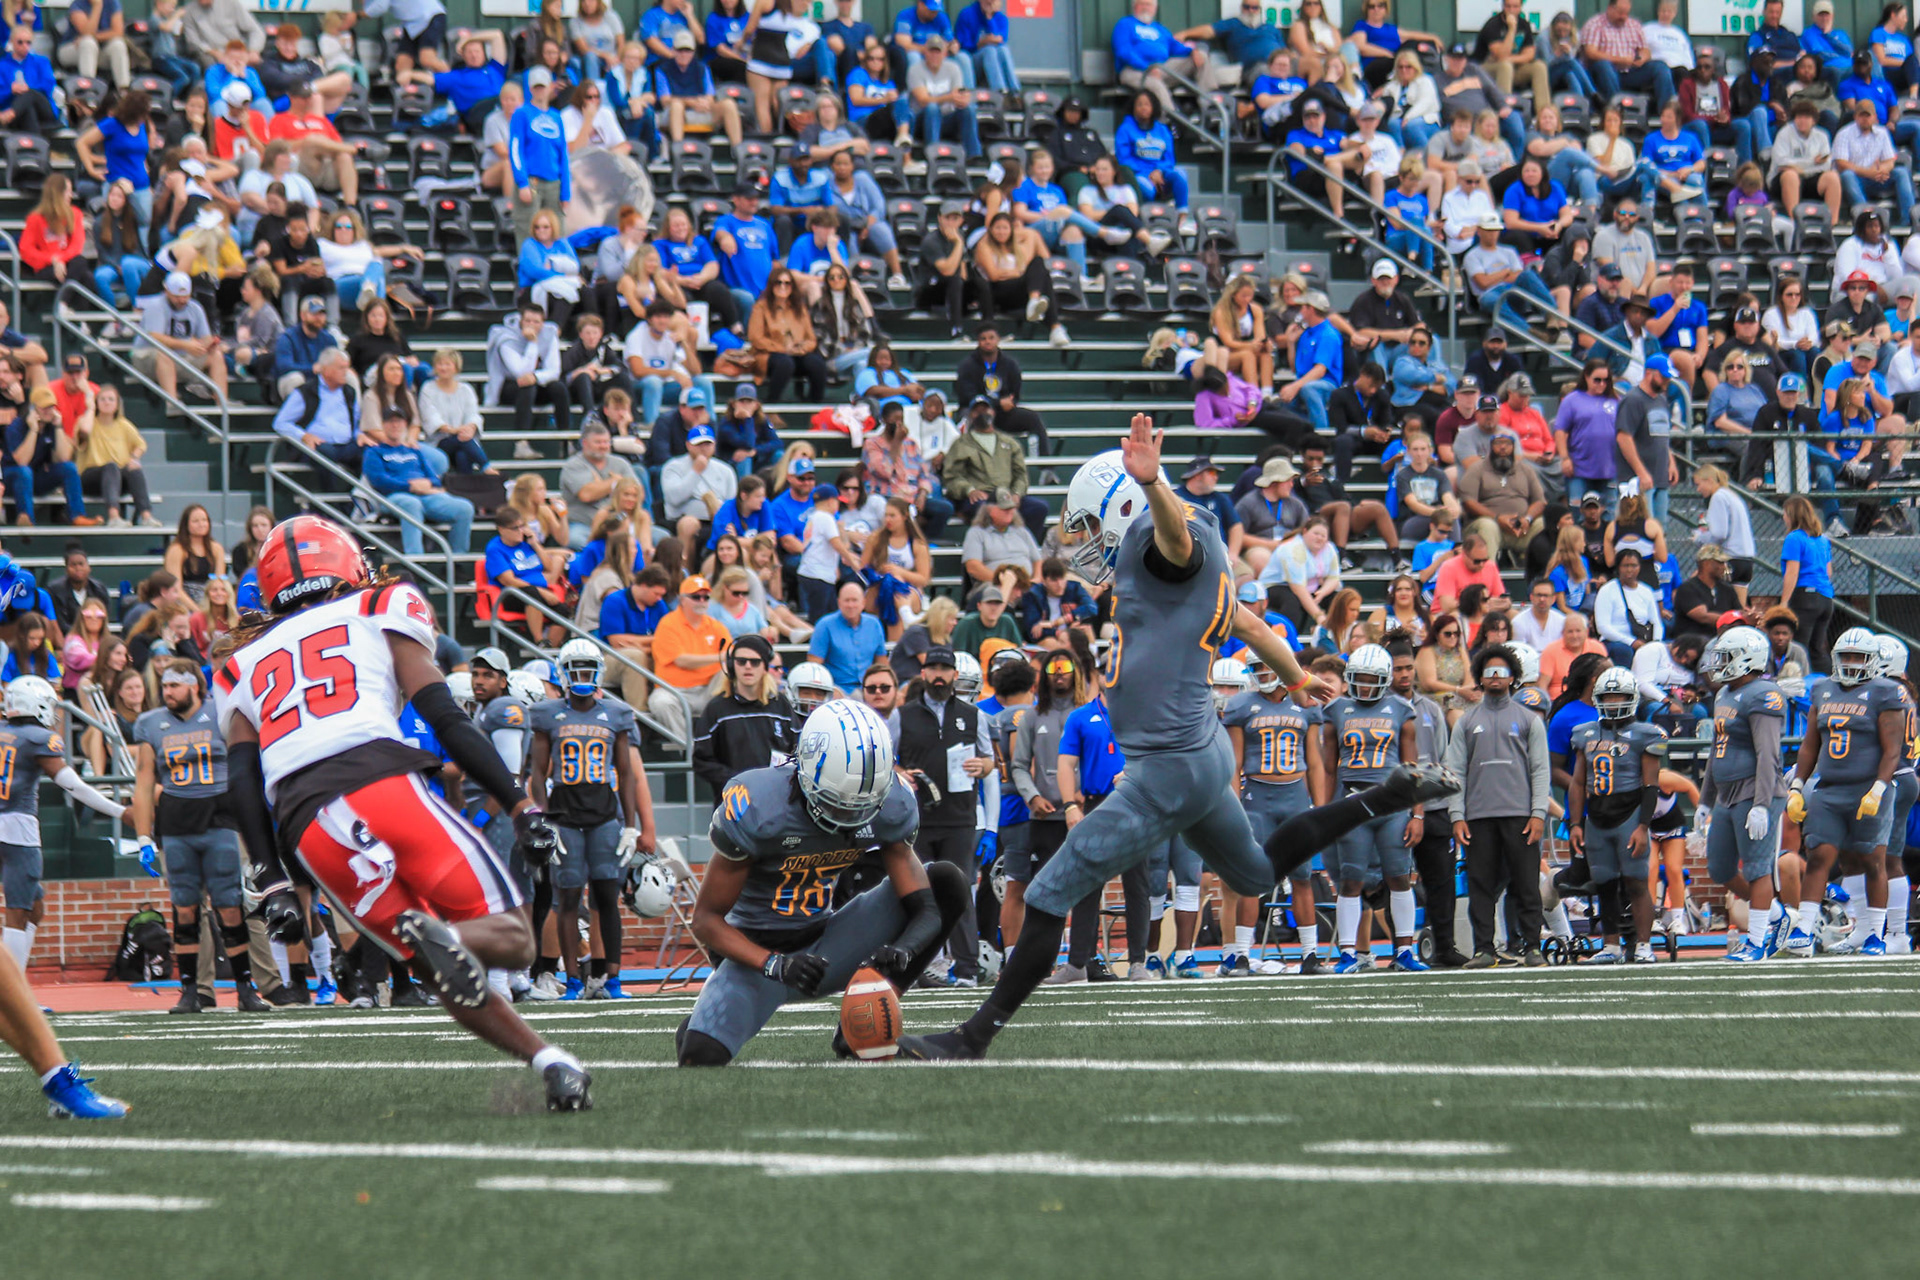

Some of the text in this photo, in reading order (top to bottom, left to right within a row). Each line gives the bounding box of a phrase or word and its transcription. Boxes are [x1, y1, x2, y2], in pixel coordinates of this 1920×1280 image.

[279, 577, 332, 605] Riddell
[250, 624, 360, 753] 25
[1258, 728, 1298, 774] 10
[1343, 729, 1394, 769] 27
[1828, 715, 1851, 759] 5
[165, 742, 214, 786] 51
[560, 738, 608, 785] 88
[1592, 753, 1613, 796] 8
